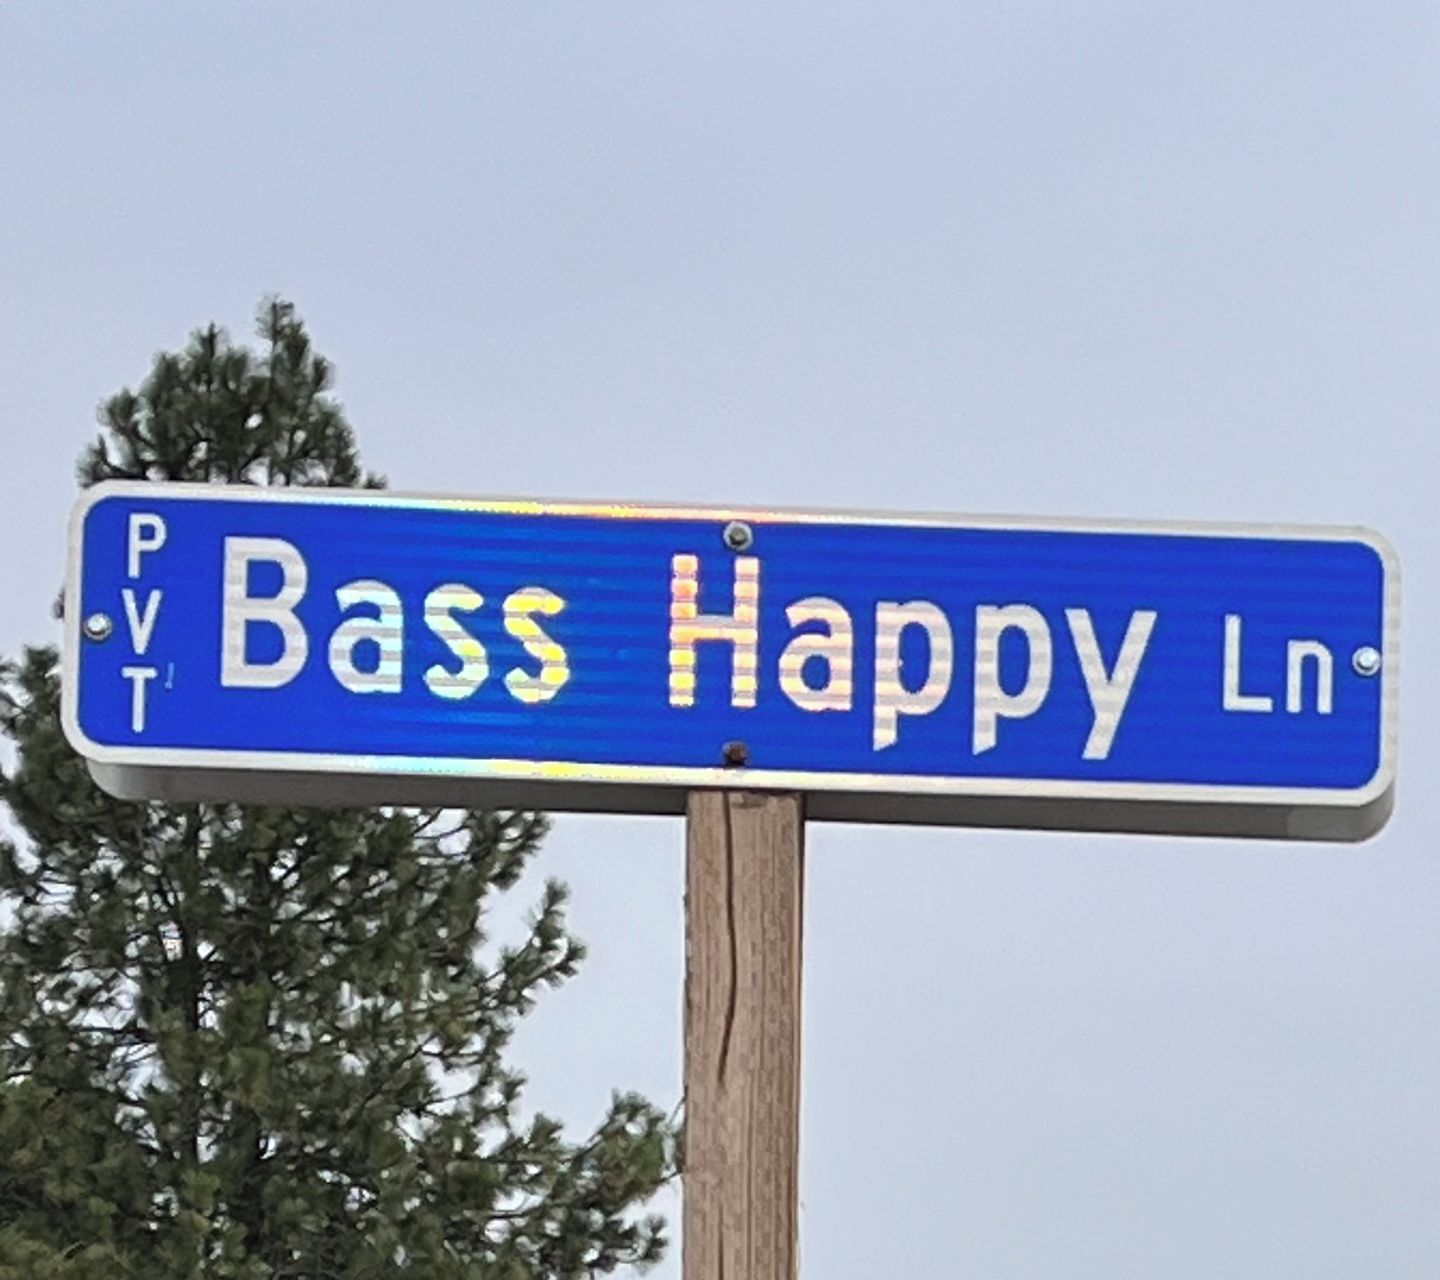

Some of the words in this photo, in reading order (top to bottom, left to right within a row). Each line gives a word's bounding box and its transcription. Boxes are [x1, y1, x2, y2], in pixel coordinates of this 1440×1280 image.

[121, 513, 168, 733] PVT
[220, 536, 570, 704] Bass
[668, 553, 1158, 760] Happy
[1223, 613, 1334, 714] Ln
